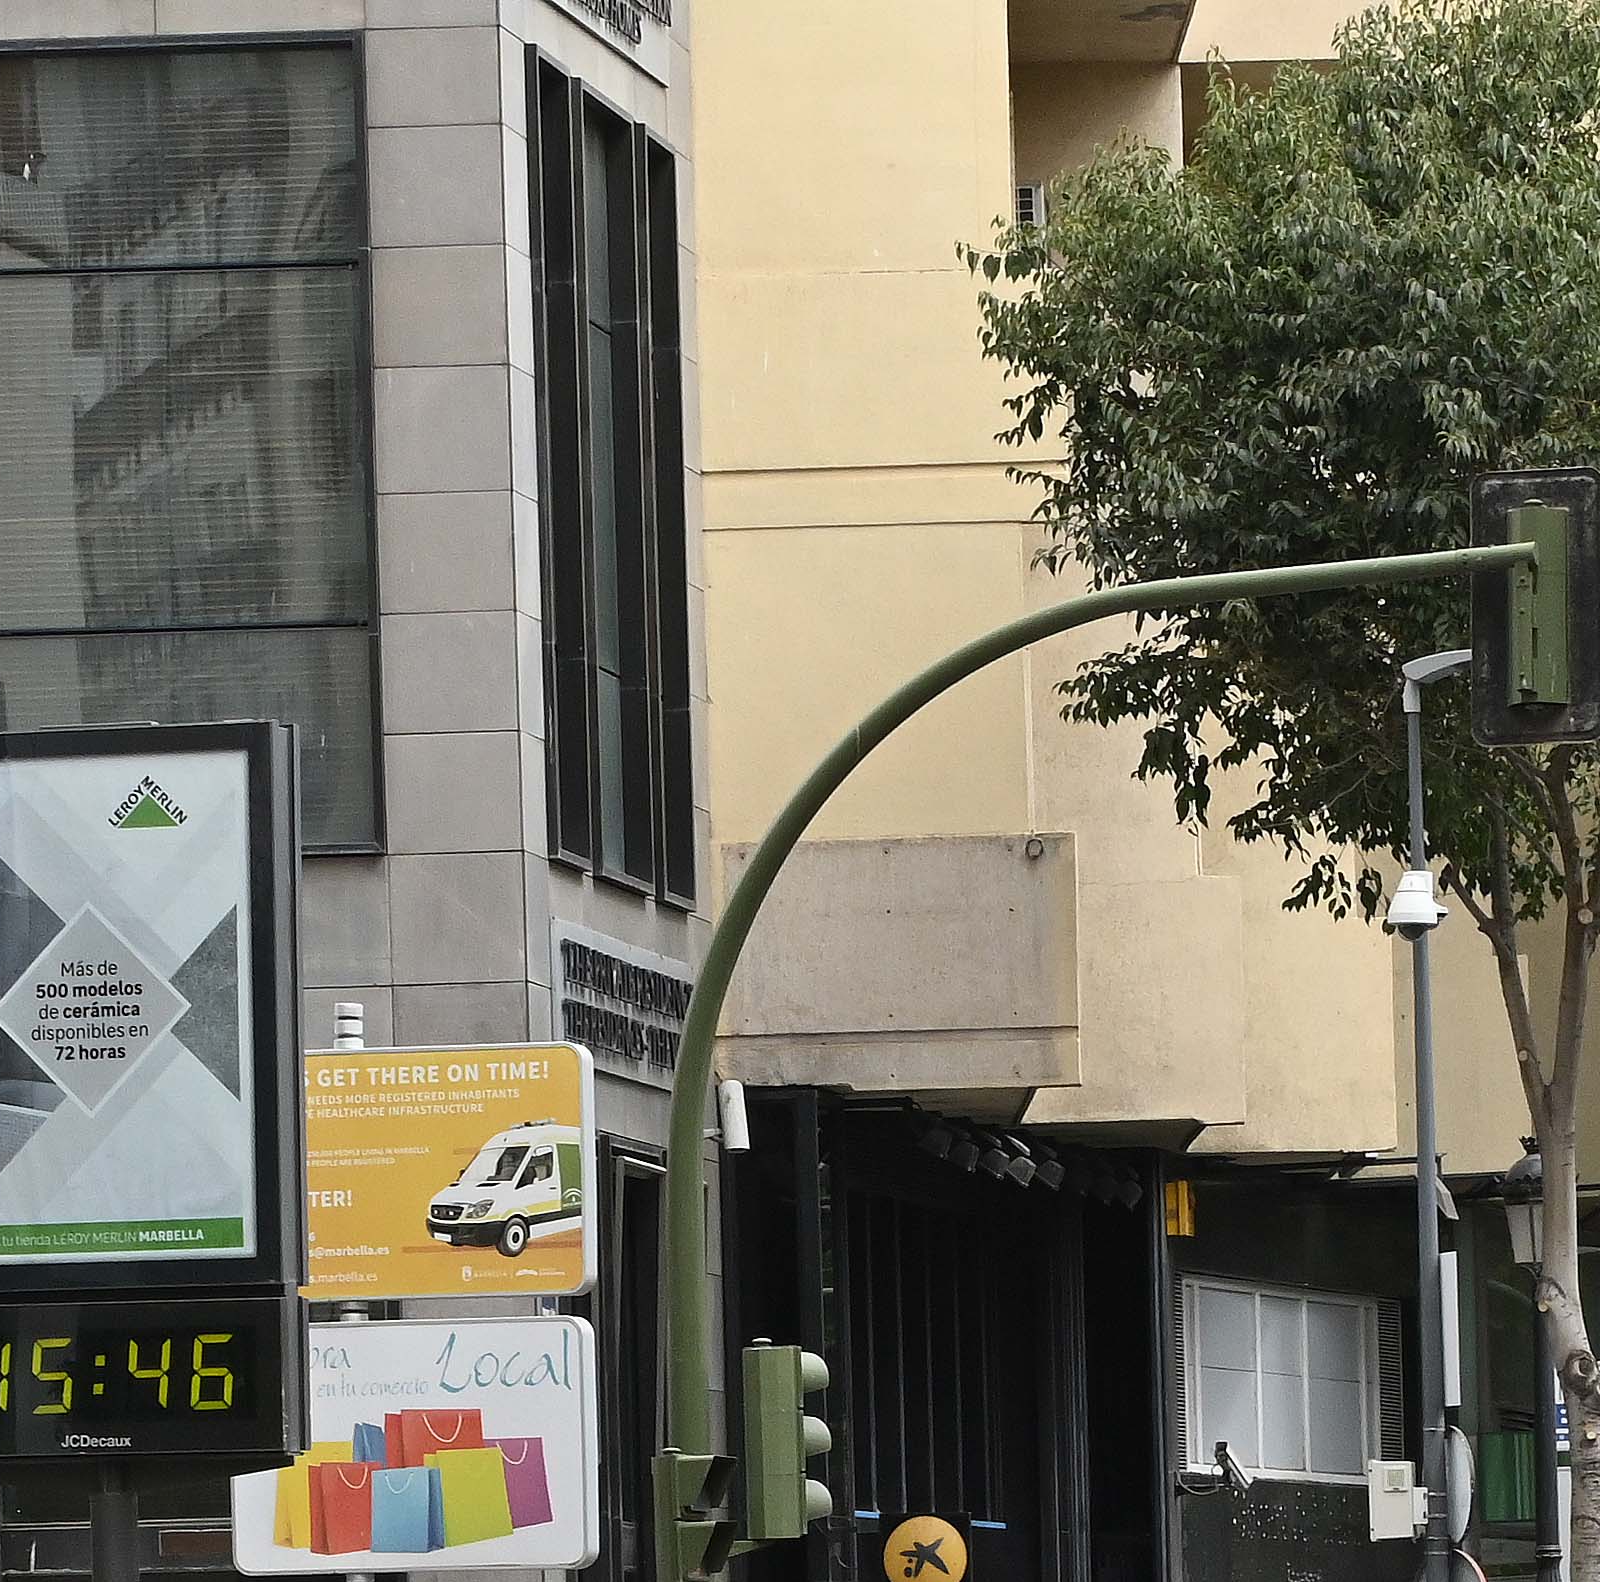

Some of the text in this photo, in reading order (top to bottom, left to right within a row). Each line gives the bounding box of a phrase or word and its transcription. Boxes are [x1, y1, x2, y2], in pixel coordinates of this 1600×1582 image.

[108, 775, 188, 827] LEROY MERLIN
[61, 960, 118, 976] Más de
[36, 980, 143, 998] 500 modelos
[39, 1001, 140, 1019] de cerámica
[32, 1024, 149, 1043] disponibles en
[55, 1045, 126, 1061] 72 horas
[317, 1060, 550, 1087] GET THERE ON TIME!
[346, 1093, 376, 1104] MORE
[379, 1091, 446, 1103] REGISTERED
[448, 1088, 520, 1101] INHABITANTS
[316, 1106, 385, 1118] HEALTHCARE
[388, 1103, 485, 1116] INFRASTRUCTURE
[309, 1190, 353, 1208] TER!
[15, 1234, 50, 1246] tienda
[53, 1233, 90, 1245] LEROY
[92, 1232, 136, 1244] MERLIN
[139, 1229, 204, 1242] MARBELLA
[436, 1328, 572, 1393] Local
[361, 1381, 432, 1397] comercio
[61, 1435, 131, 1448] JCDecaux
